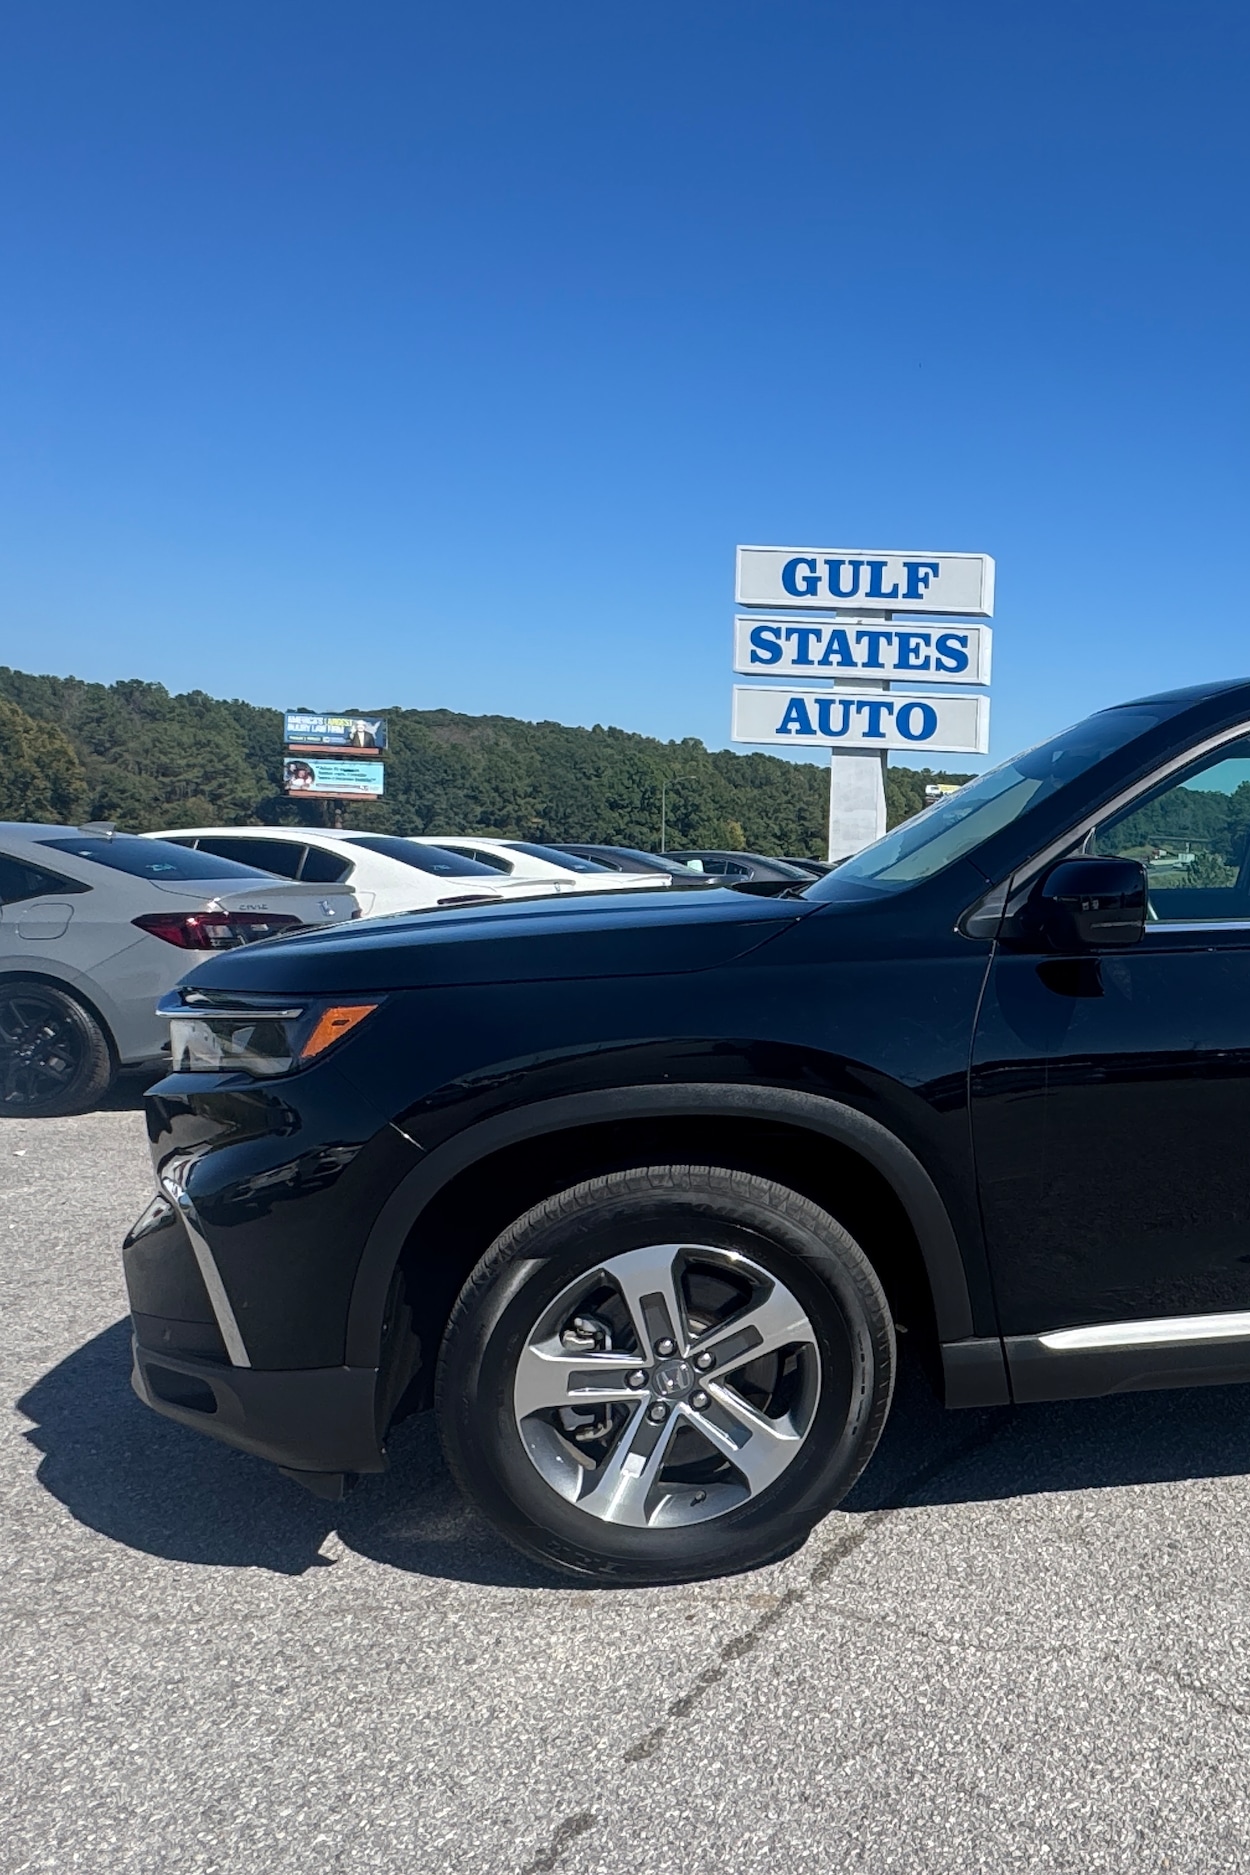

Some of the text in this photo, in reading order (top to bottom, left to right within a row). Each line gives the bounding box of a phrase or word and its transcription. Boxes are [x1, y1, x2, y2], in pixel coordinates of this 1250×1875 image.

[782, 558, 939, 599] GULF
[750, 626, 968, 672] STATES
[776, 698, 937, 740] AUTO
